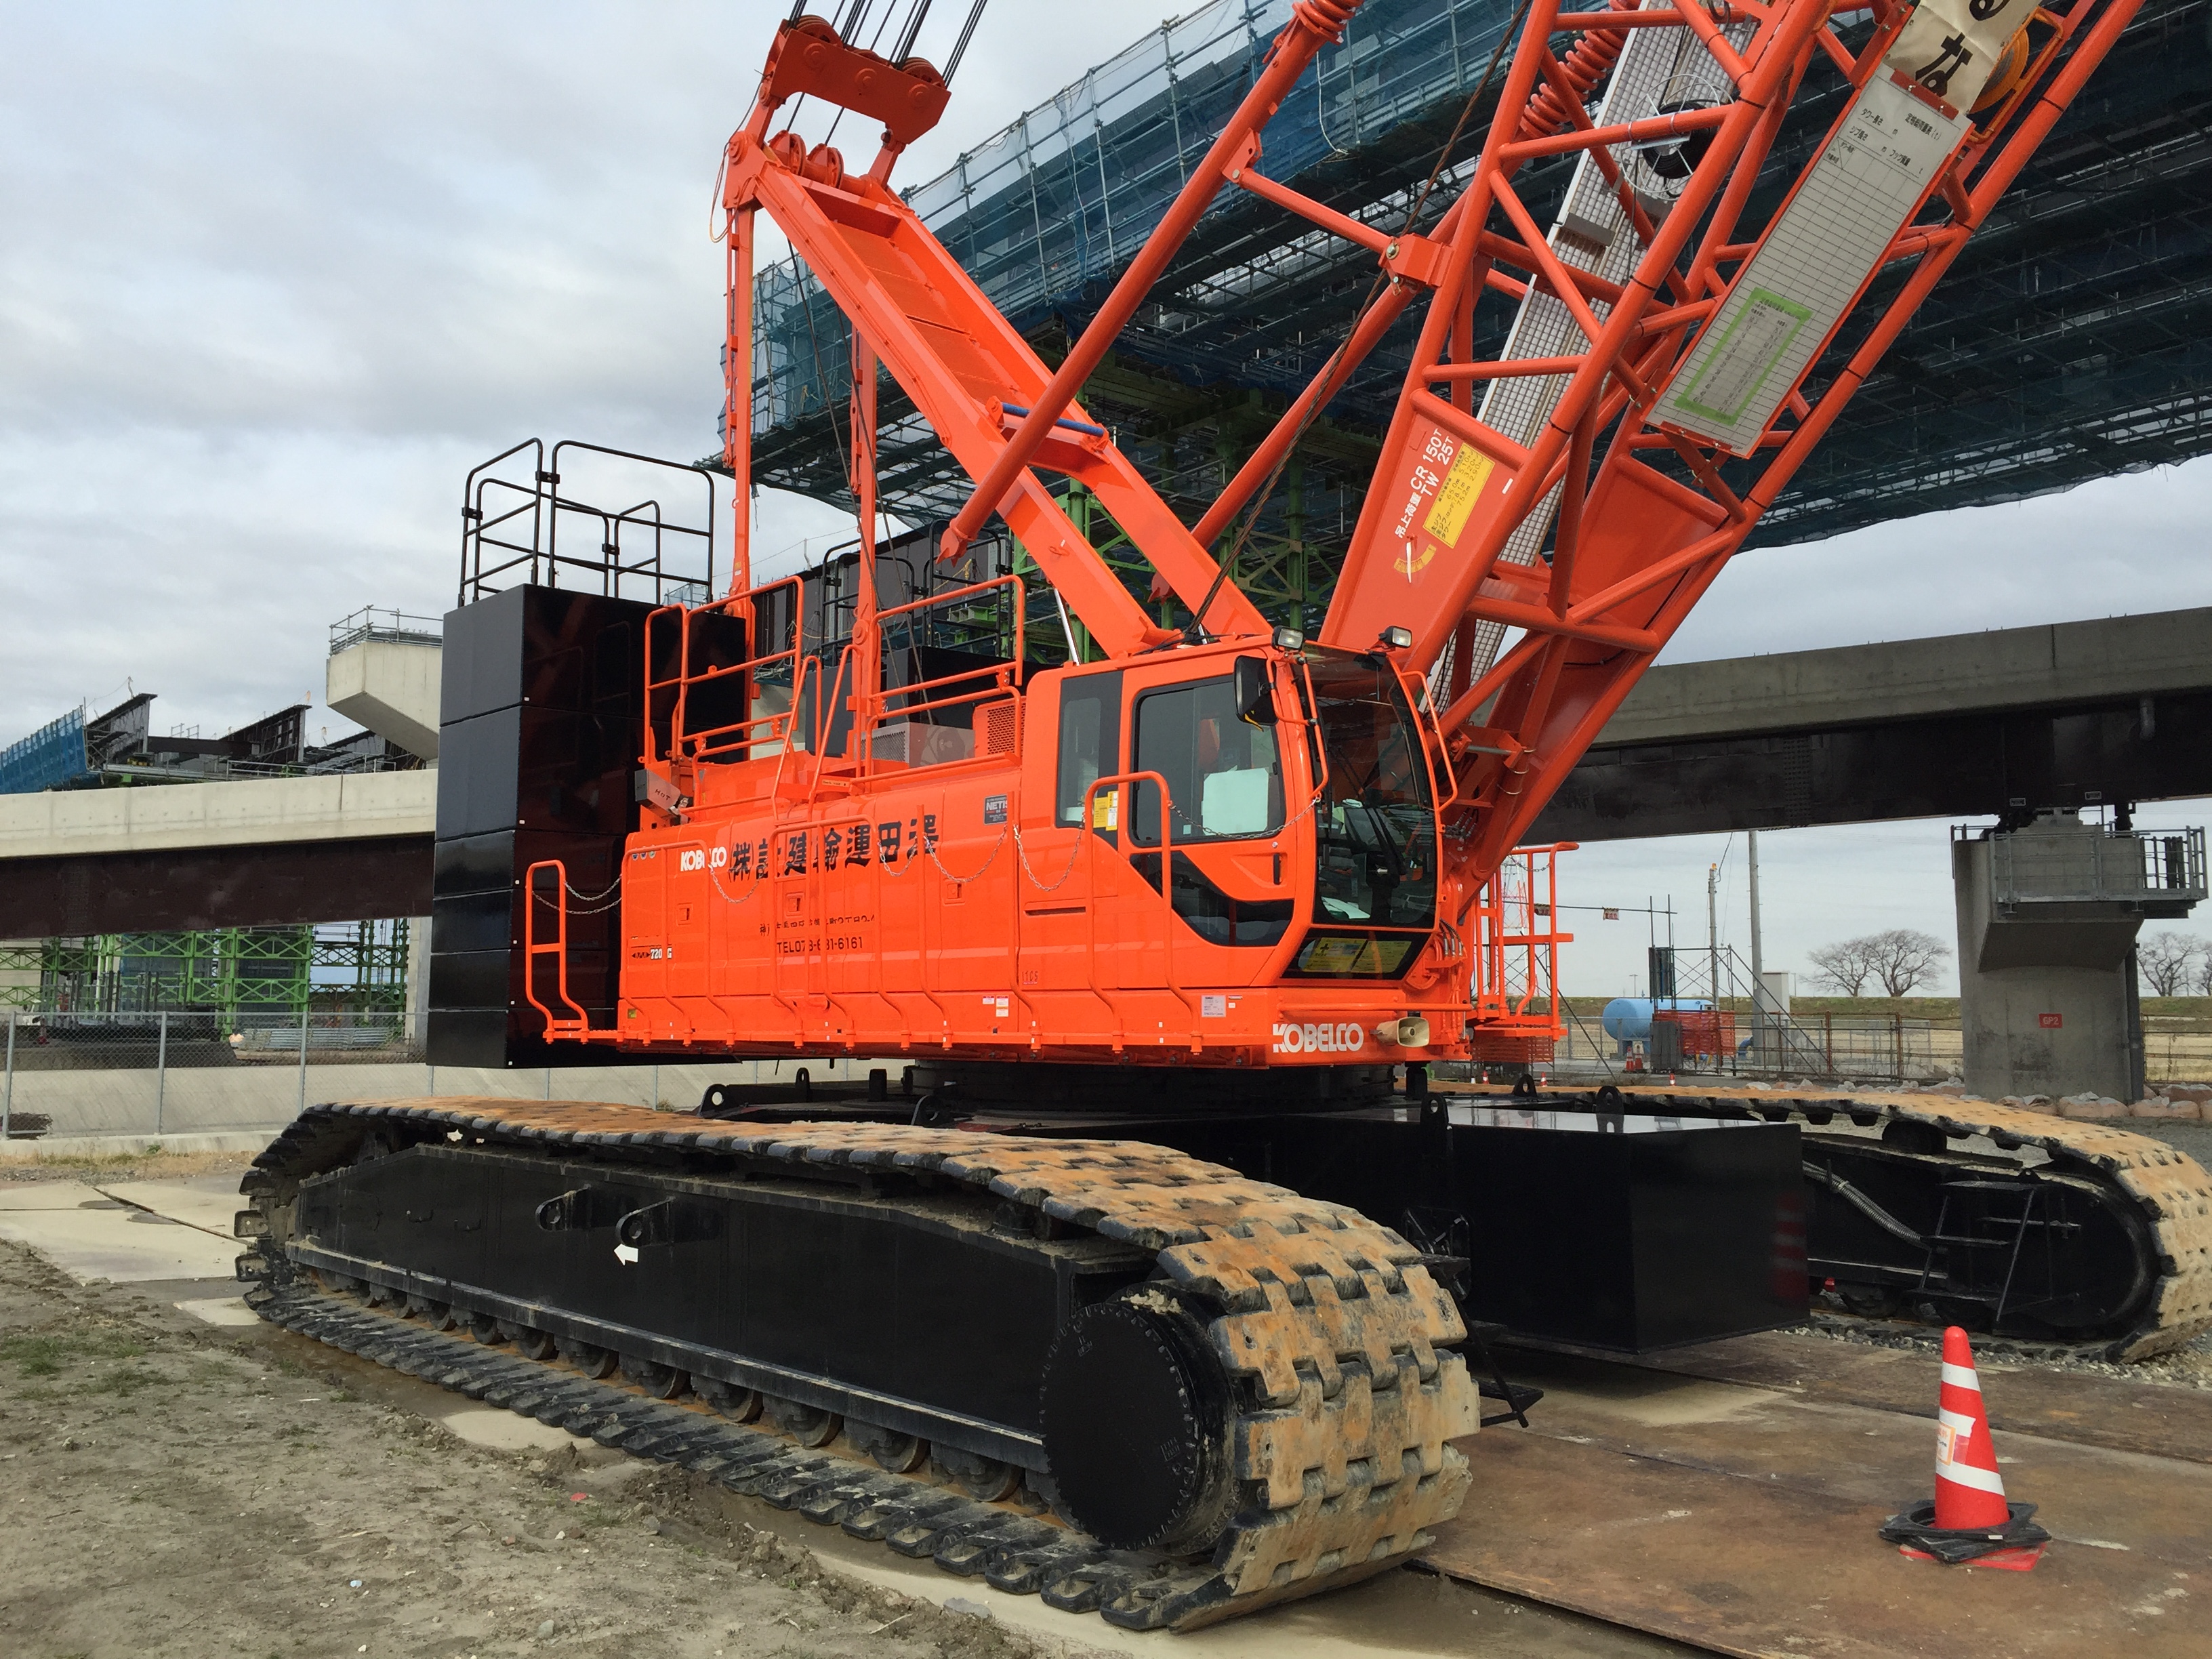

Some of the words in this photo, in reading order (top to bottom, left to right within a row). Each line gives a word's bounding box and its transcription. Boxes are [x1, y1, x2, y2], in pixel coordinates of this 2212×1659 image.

[1408, 464, 1430, 491] CR
[1419, 471, 1441, 498] TW
[1391, 491, 1425, 539] 吊上荷重
[655, 788, 671, 801] HOT
[2042, 1016, 2060, 1025] GP2
[1272, 1023, 1365, 1053] KOBELCO
